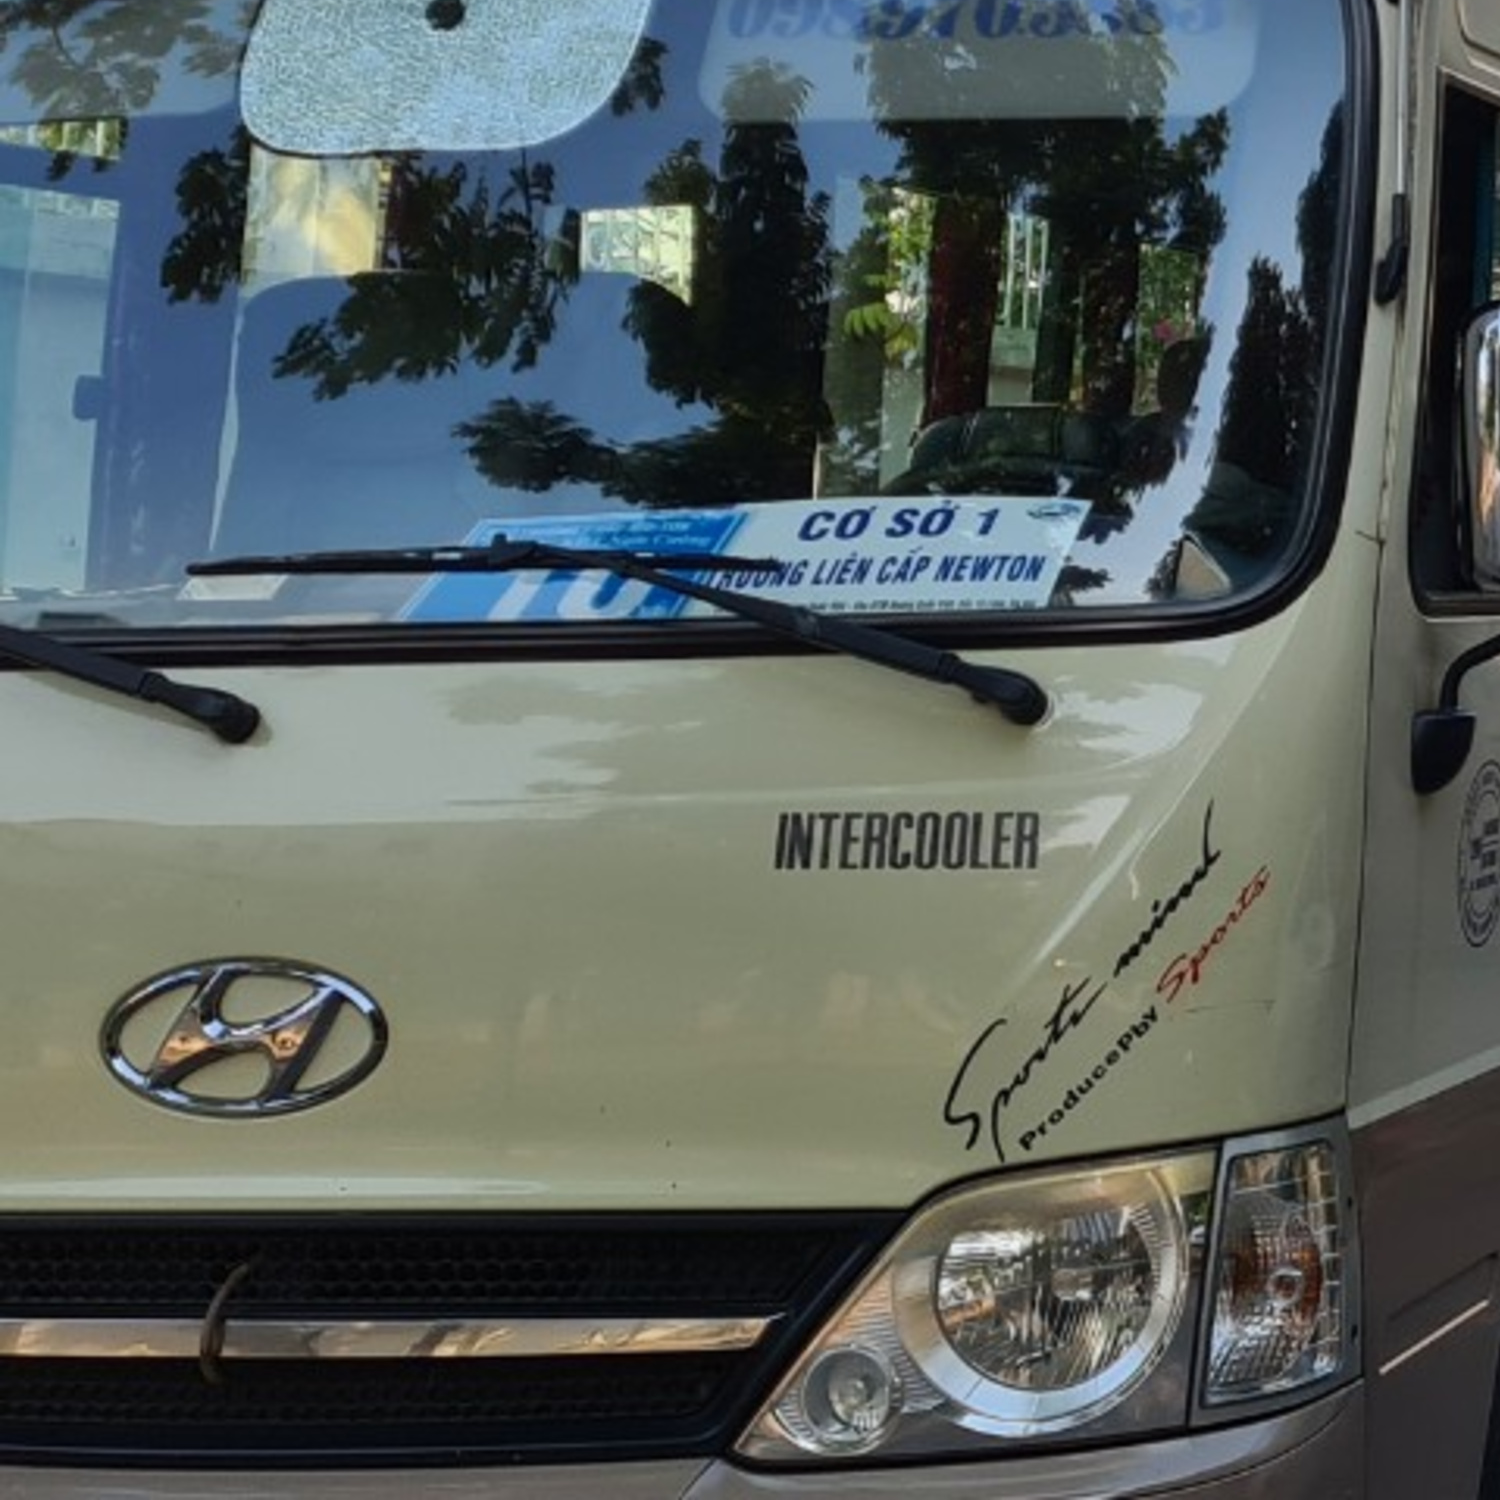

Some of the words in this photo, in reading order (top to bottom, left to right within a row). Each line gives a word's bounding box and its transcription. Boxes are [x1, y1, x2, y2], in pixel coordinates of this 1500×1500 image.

[798, 505, 877, 542] CƠ
[884, 499, 961, 539] SỞ
[976, 508, 1001, 536] 1
[876, 545, 932, 584] CẤP
[934, 554, 1047, 583] NEWTON
[774, 811, 1040, 870] INTERCOOLER
[1155, 864, 1272, 1004] Sports
